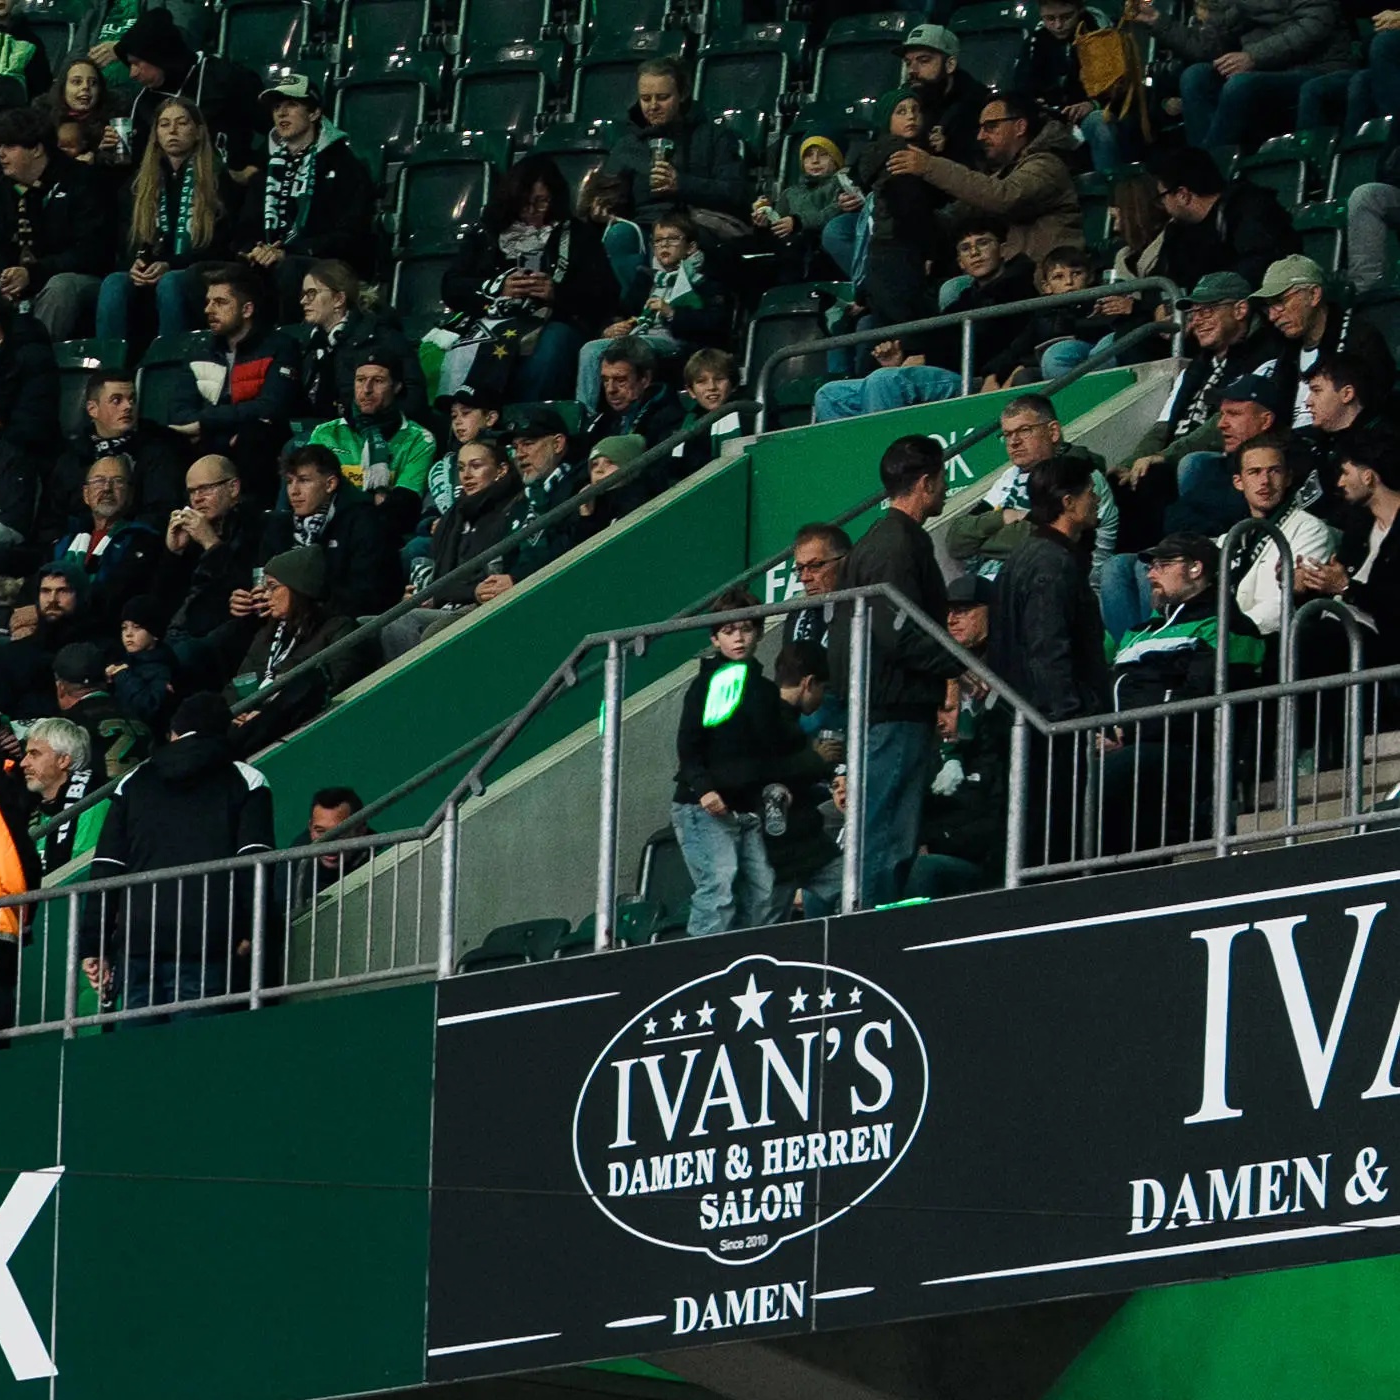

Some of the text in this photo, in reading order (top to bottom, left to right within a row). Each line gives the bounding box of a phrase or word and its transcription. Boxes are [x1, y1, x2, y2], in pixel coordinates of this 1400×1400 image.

[608, 1018, 895, 1149] IVAN'S
[607, 1122, 894, 1197] DAMEN & HERREN
[1125, 1146, 1389, 1236] DAMEN &
[699, 1181, 805, 1230] SALON
[719, 1233, 769, 1252] Since 2010
[672, 1280, 808, 1336] DAMEN
